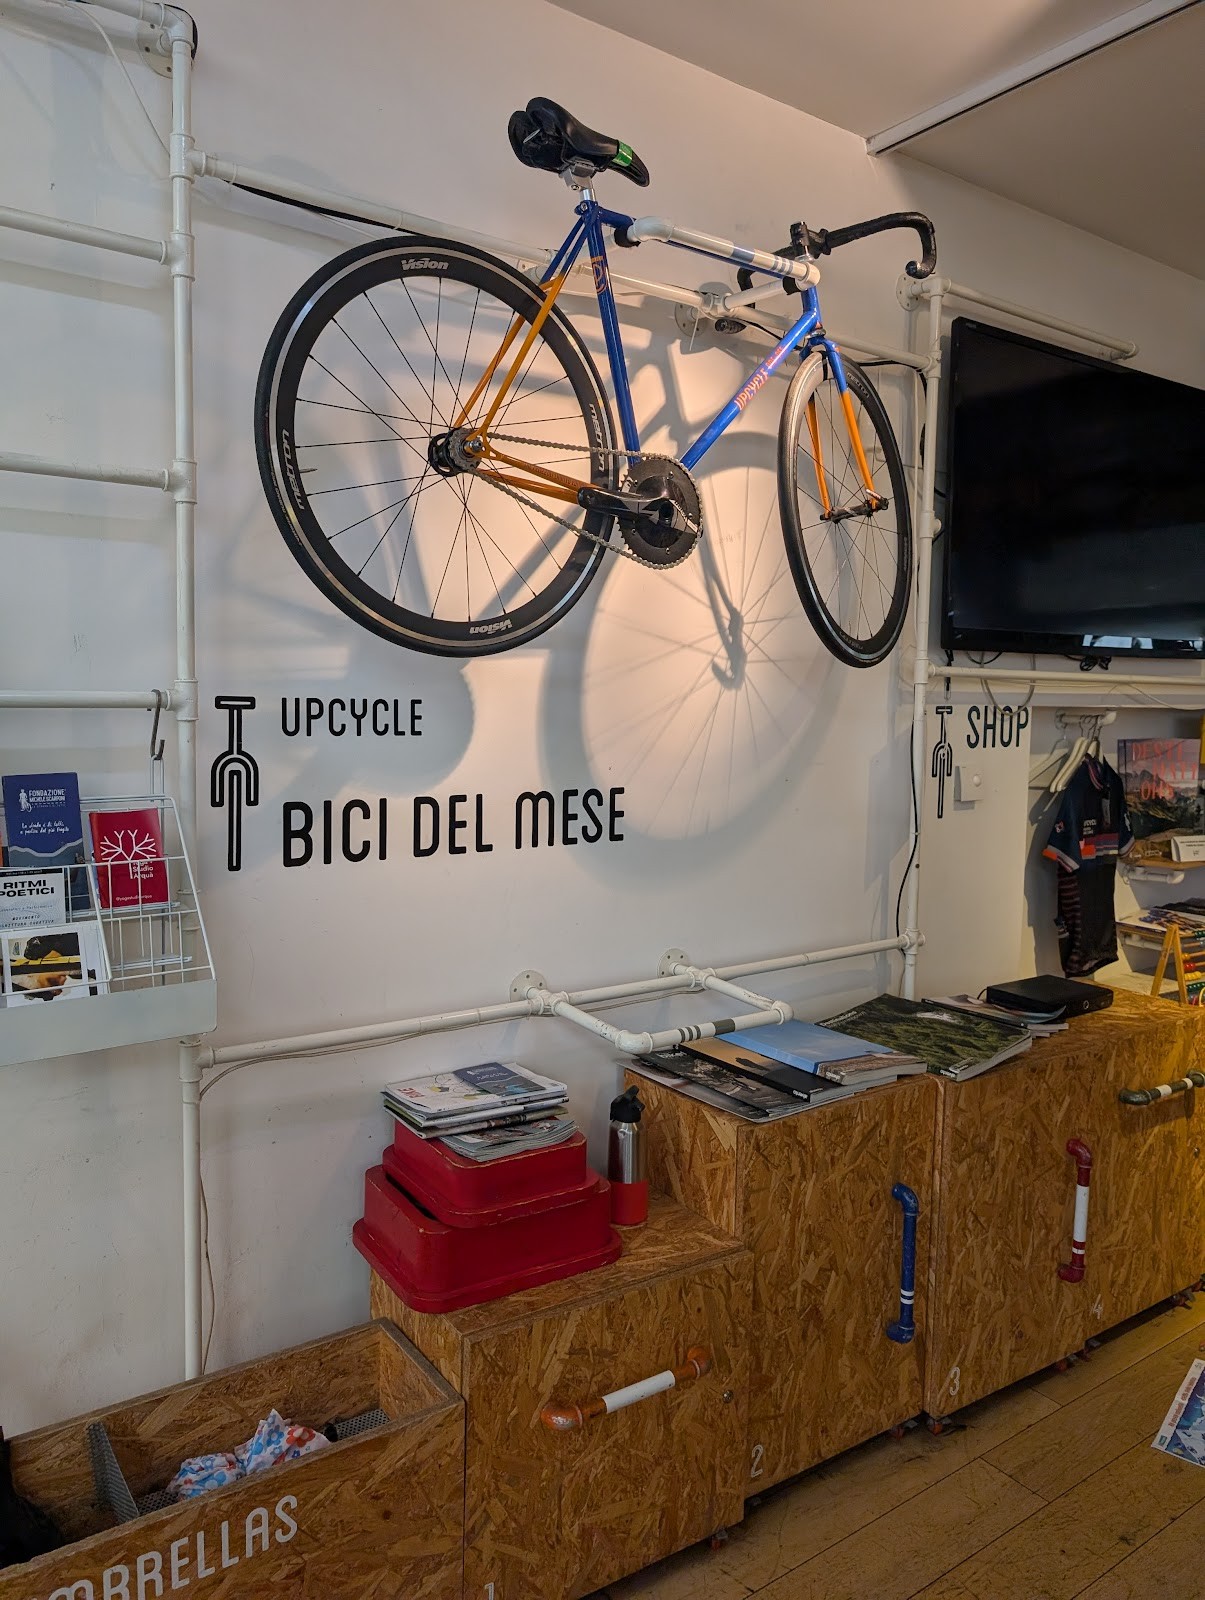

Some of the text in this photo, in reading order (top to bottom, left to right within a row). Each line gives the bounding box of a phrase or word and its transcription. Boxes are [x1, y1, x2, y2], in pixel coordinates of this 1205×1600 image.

[401, 257, 449, 270] Vision
[469, 619, 513, 635] Vision
[281, 696, 423, 737] UPCYCLE
[966, 705, 1030, 749] SHOP
[28, 788, 66, 797] FONDAZIONE
[282, 786, 626, 868] BICI DEL MESE
[132, 865, 154, 873] Sudio
[133, 872, 154, 880] Aquà
[3, 879, 47, 890] RITMI
[949, 1366, 961, 1396] 3
[749, 1444, 764, 1479] 2
[32, 1494, 298, 1600] BRELLAS
